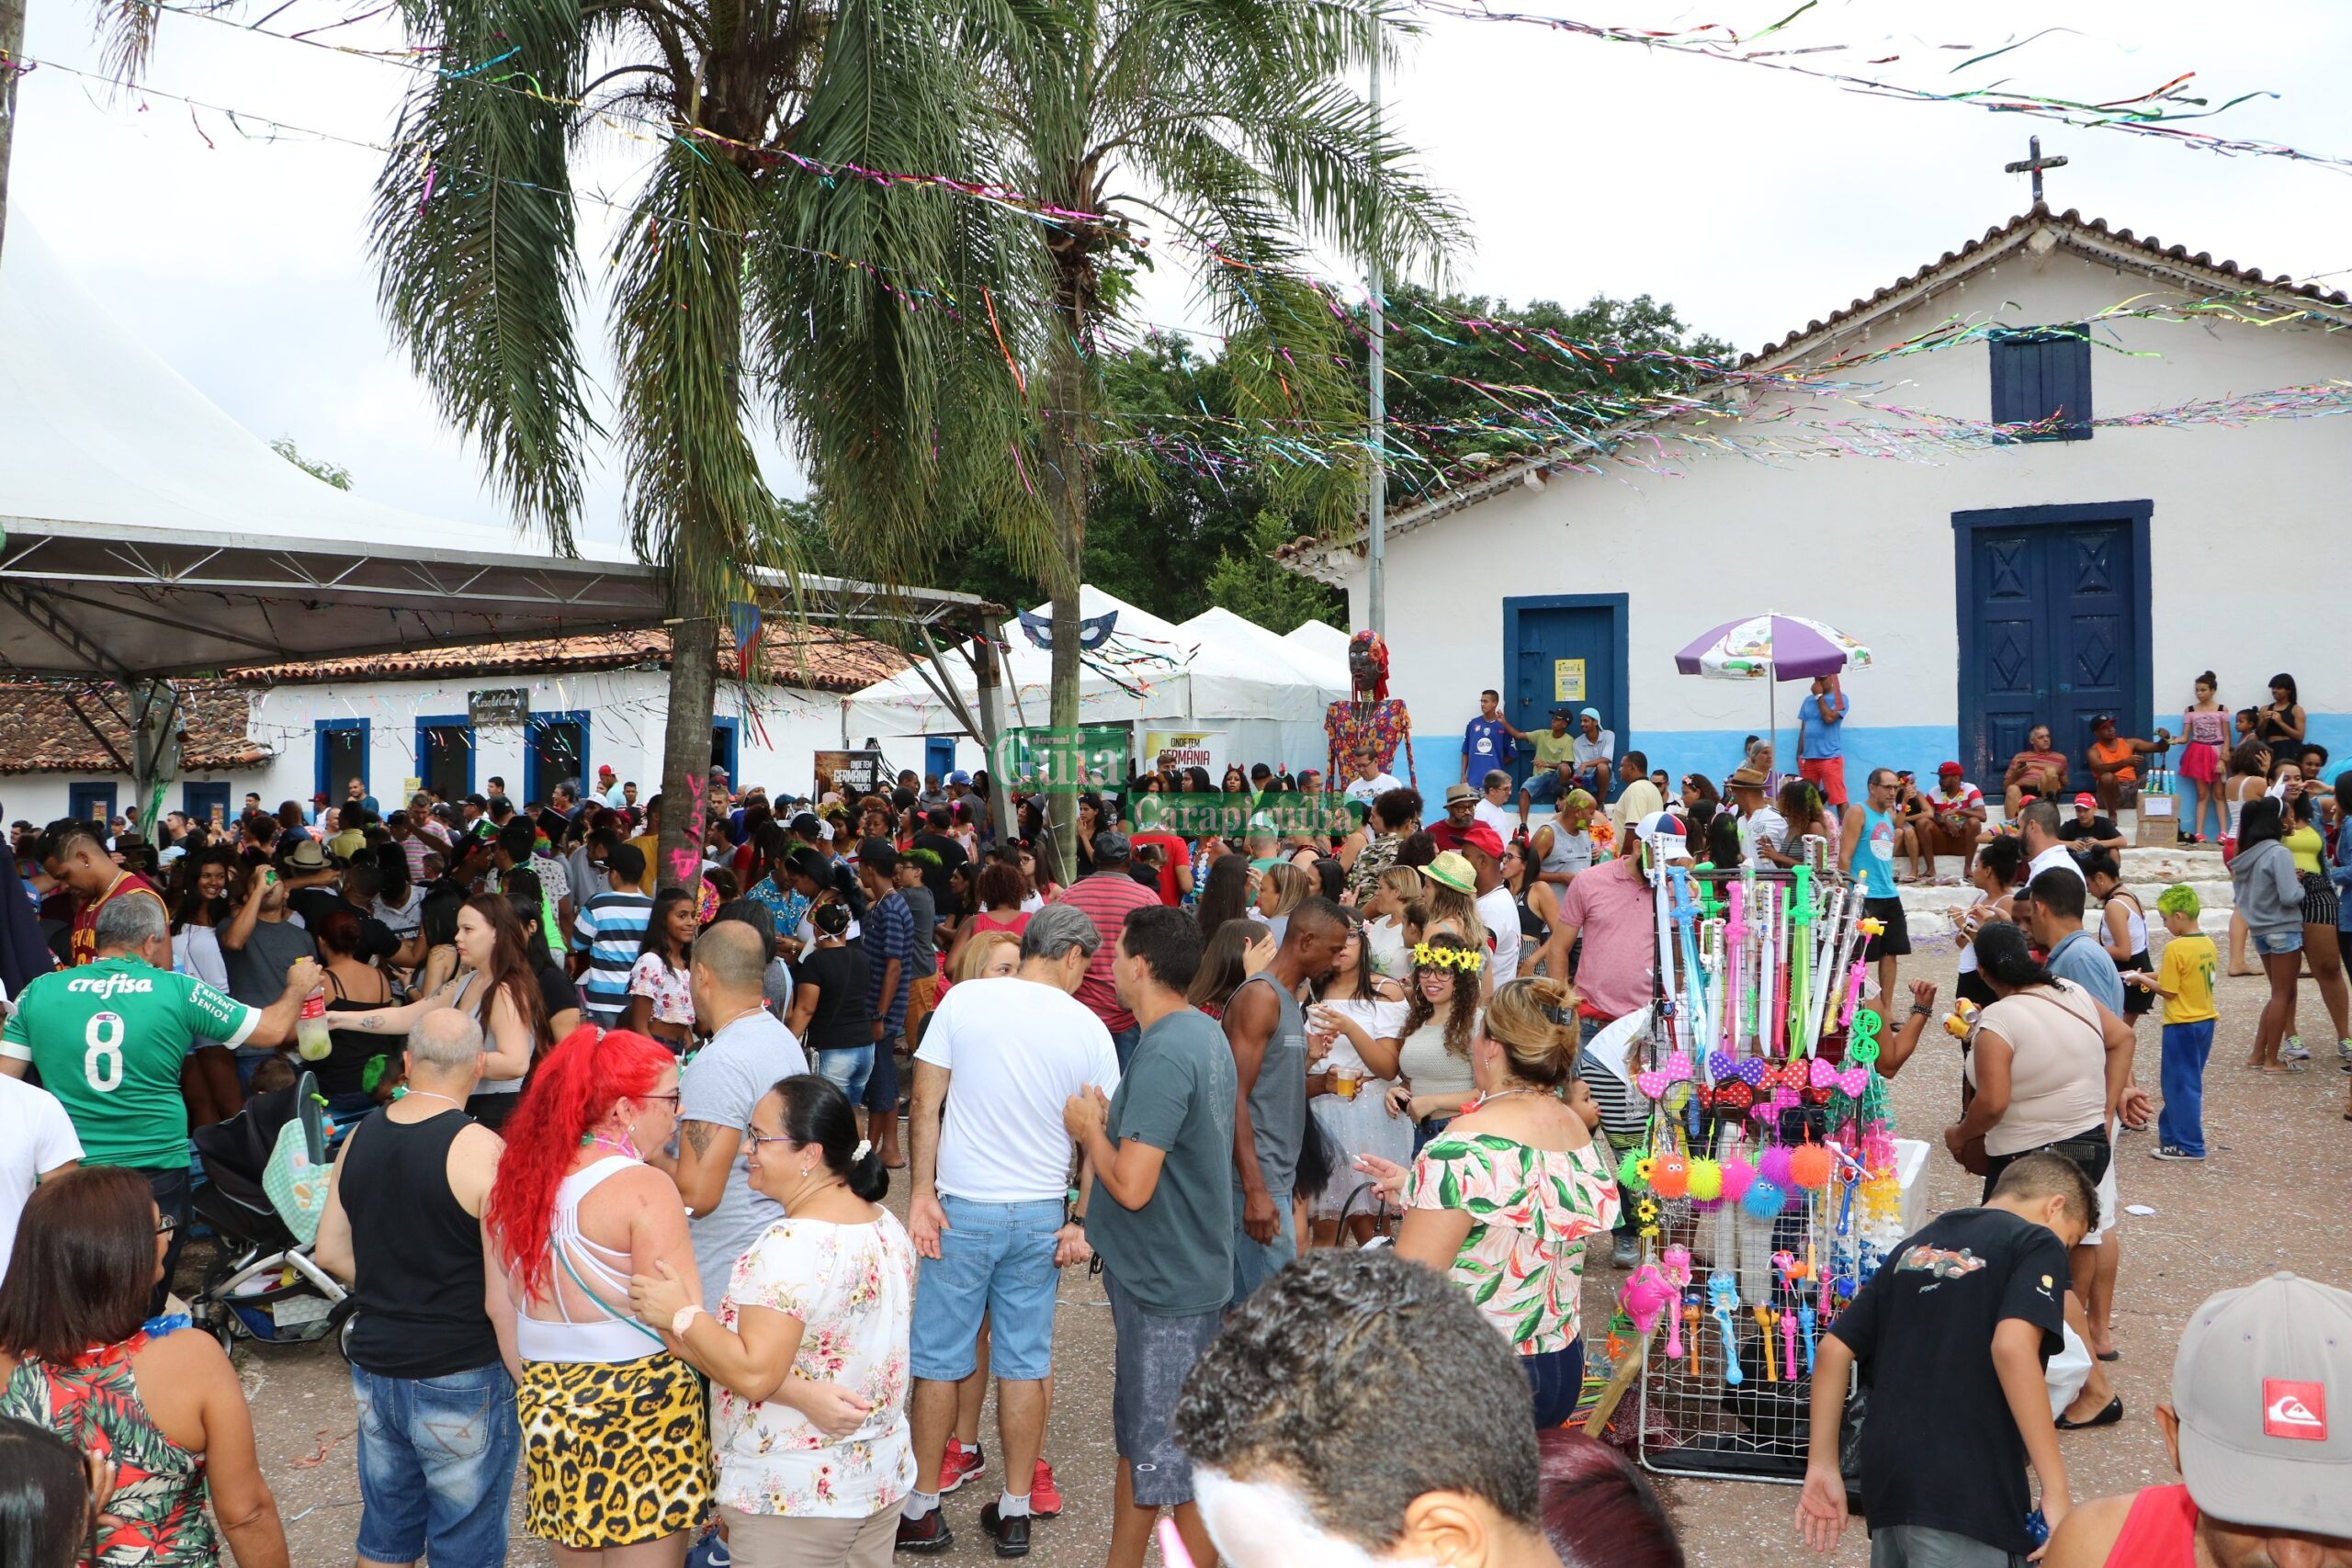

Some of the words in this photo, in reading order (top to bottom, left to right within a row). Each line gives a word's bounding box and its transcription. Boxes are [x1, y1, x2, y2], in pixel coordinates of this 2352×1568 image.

[1170, 738, 1187, 747] ONDE
[1187, 739, 1200, 747] TEM
[68, 974, 153, 999] crefisa
[85, 1011, 124, 1092] 8
